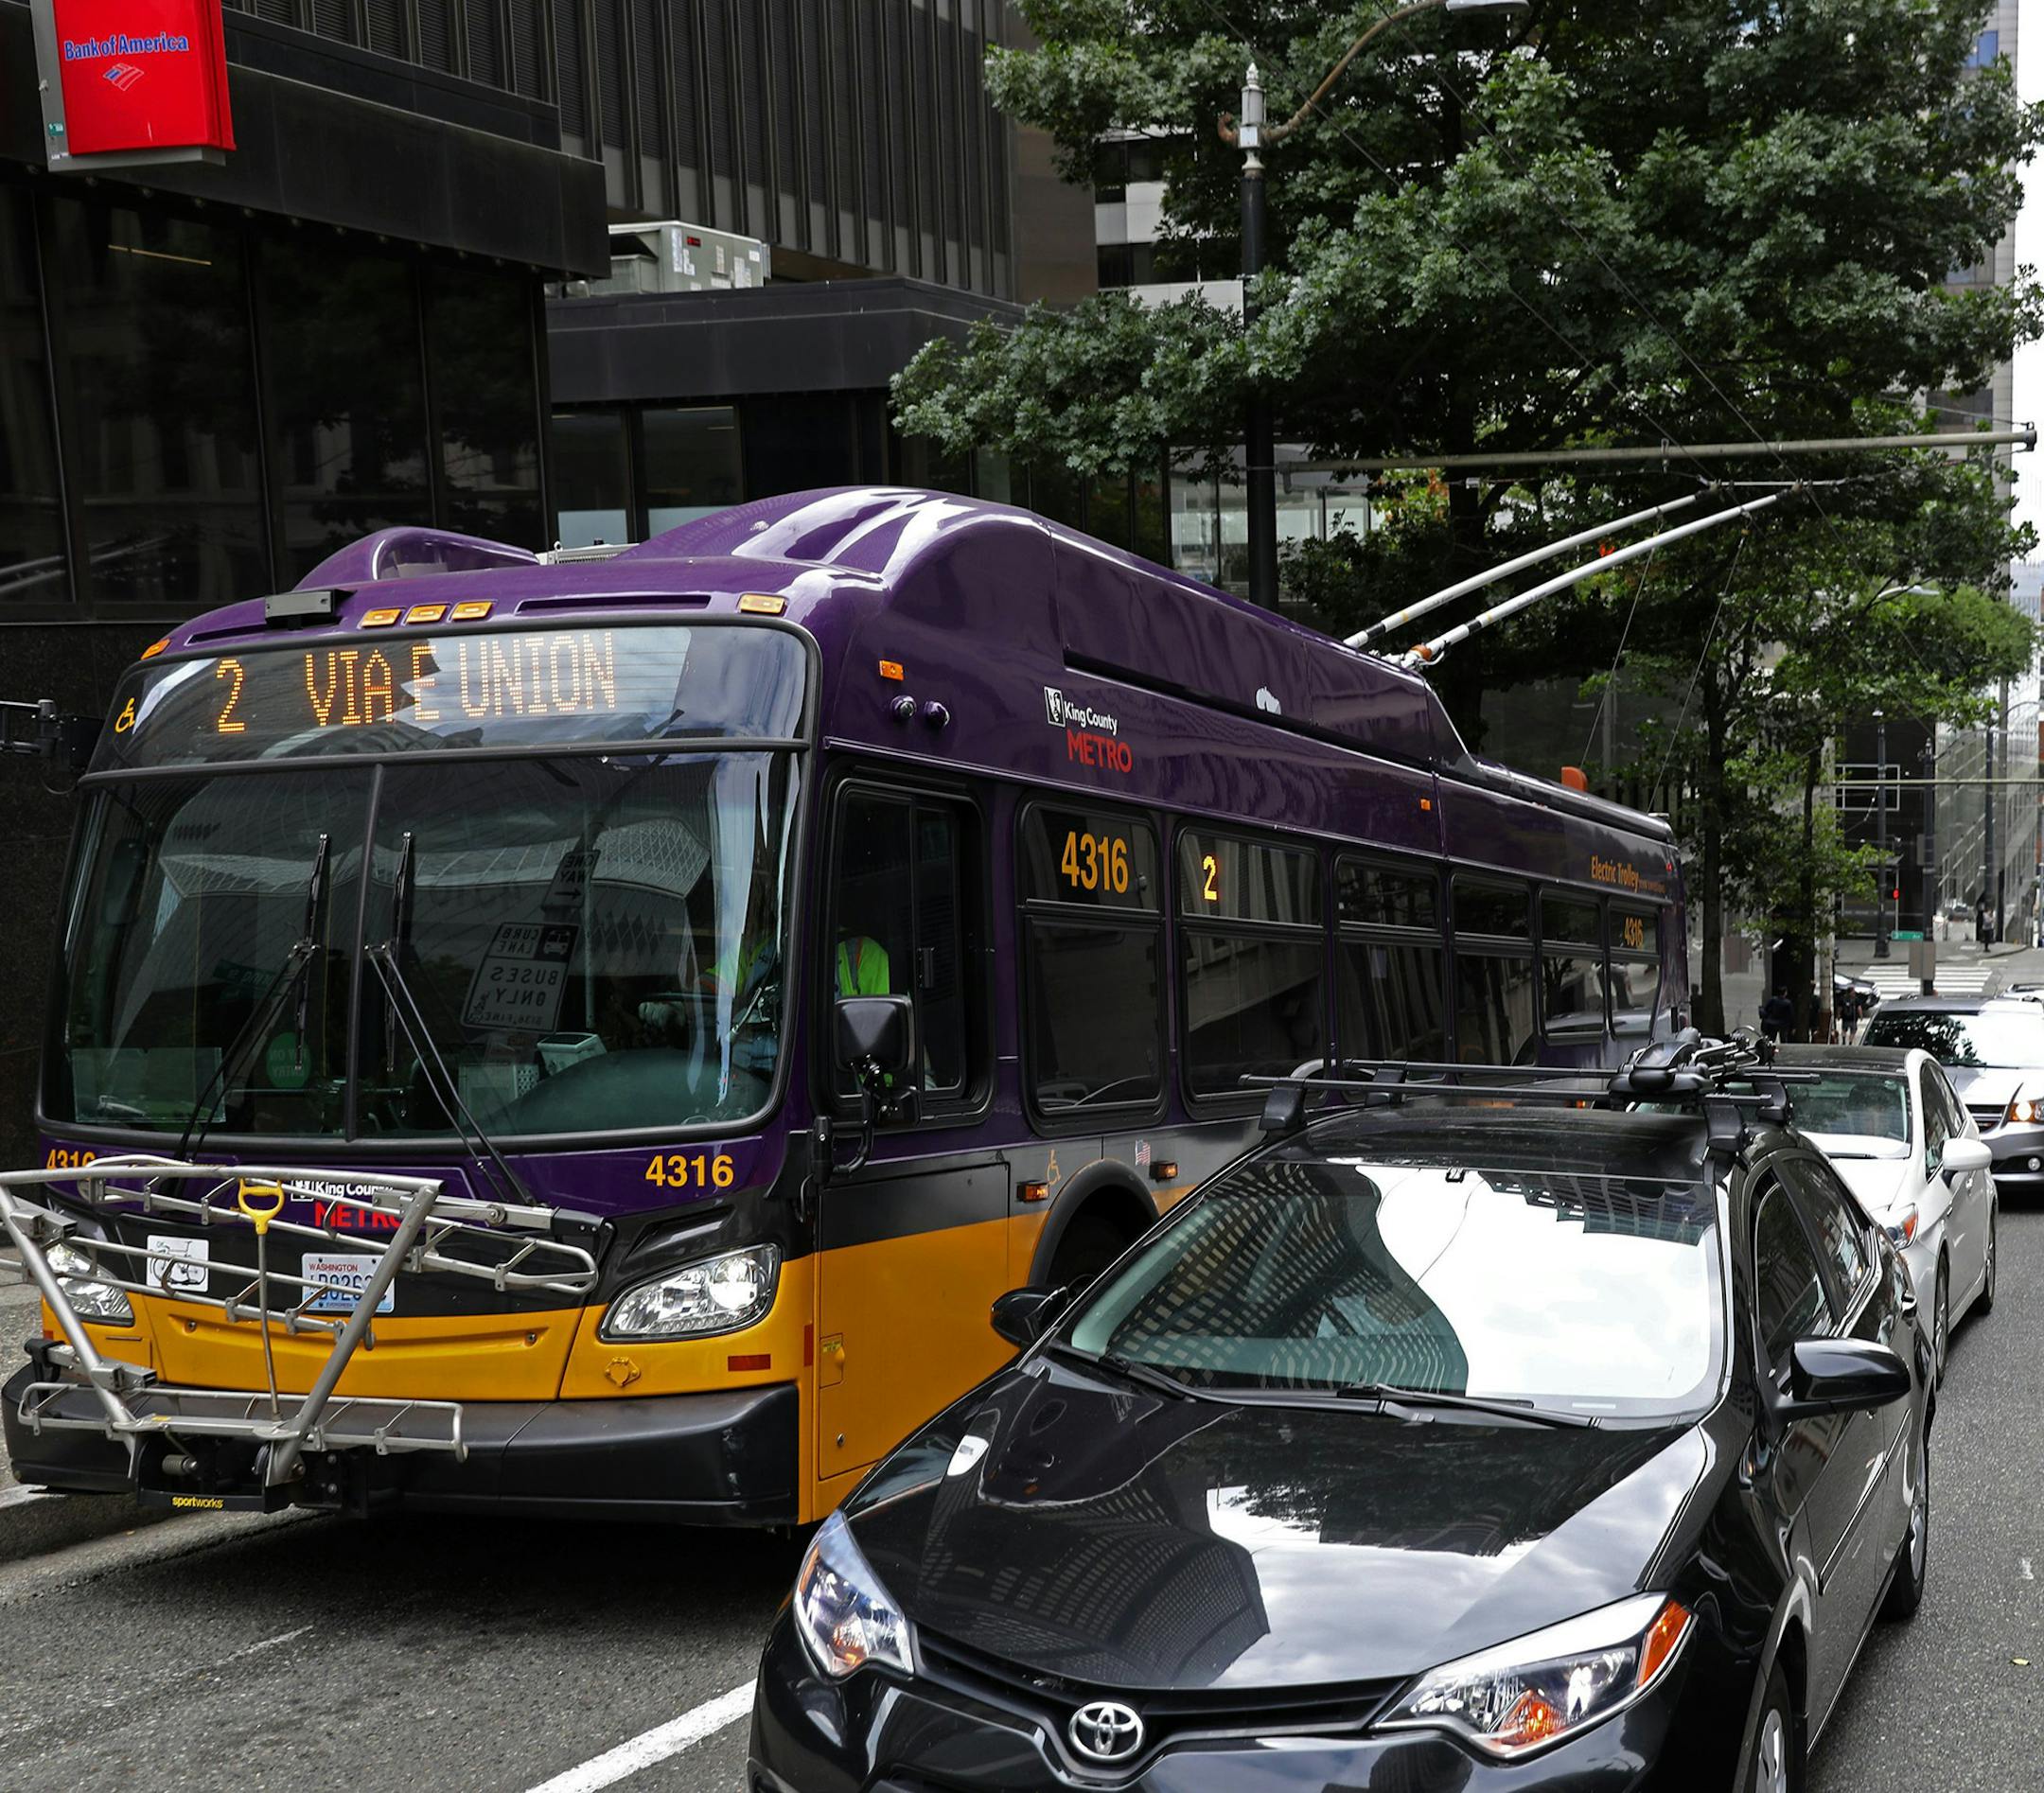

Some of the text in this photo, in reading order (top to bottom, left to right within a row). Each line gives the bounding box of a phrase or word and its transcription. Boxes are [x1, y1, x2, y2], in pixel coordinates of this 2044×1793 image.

[64, 31, 189, 61] Bank of America
[217, 632, 615, 732] 2 VIA E UNION
[1065, 701, 1118, 736] King County
[1066, 728, 1133, 773] METRO
[1061, 831, 1129, 894] 4316
[1203, 854, 1218, 901] 2
[1592, 855, 1616, 883] Electric
[1617, 862, 1639, 894] Trolley
[1625, 917, 1644, 951] 4316
[645, 1154, 734, 1187] 4316
[315, 1181, 393, 1197] King Coun
[309, 1263, 359, 1273] WASHINGTON
[172, 1497, 224, 1509] sportworks
